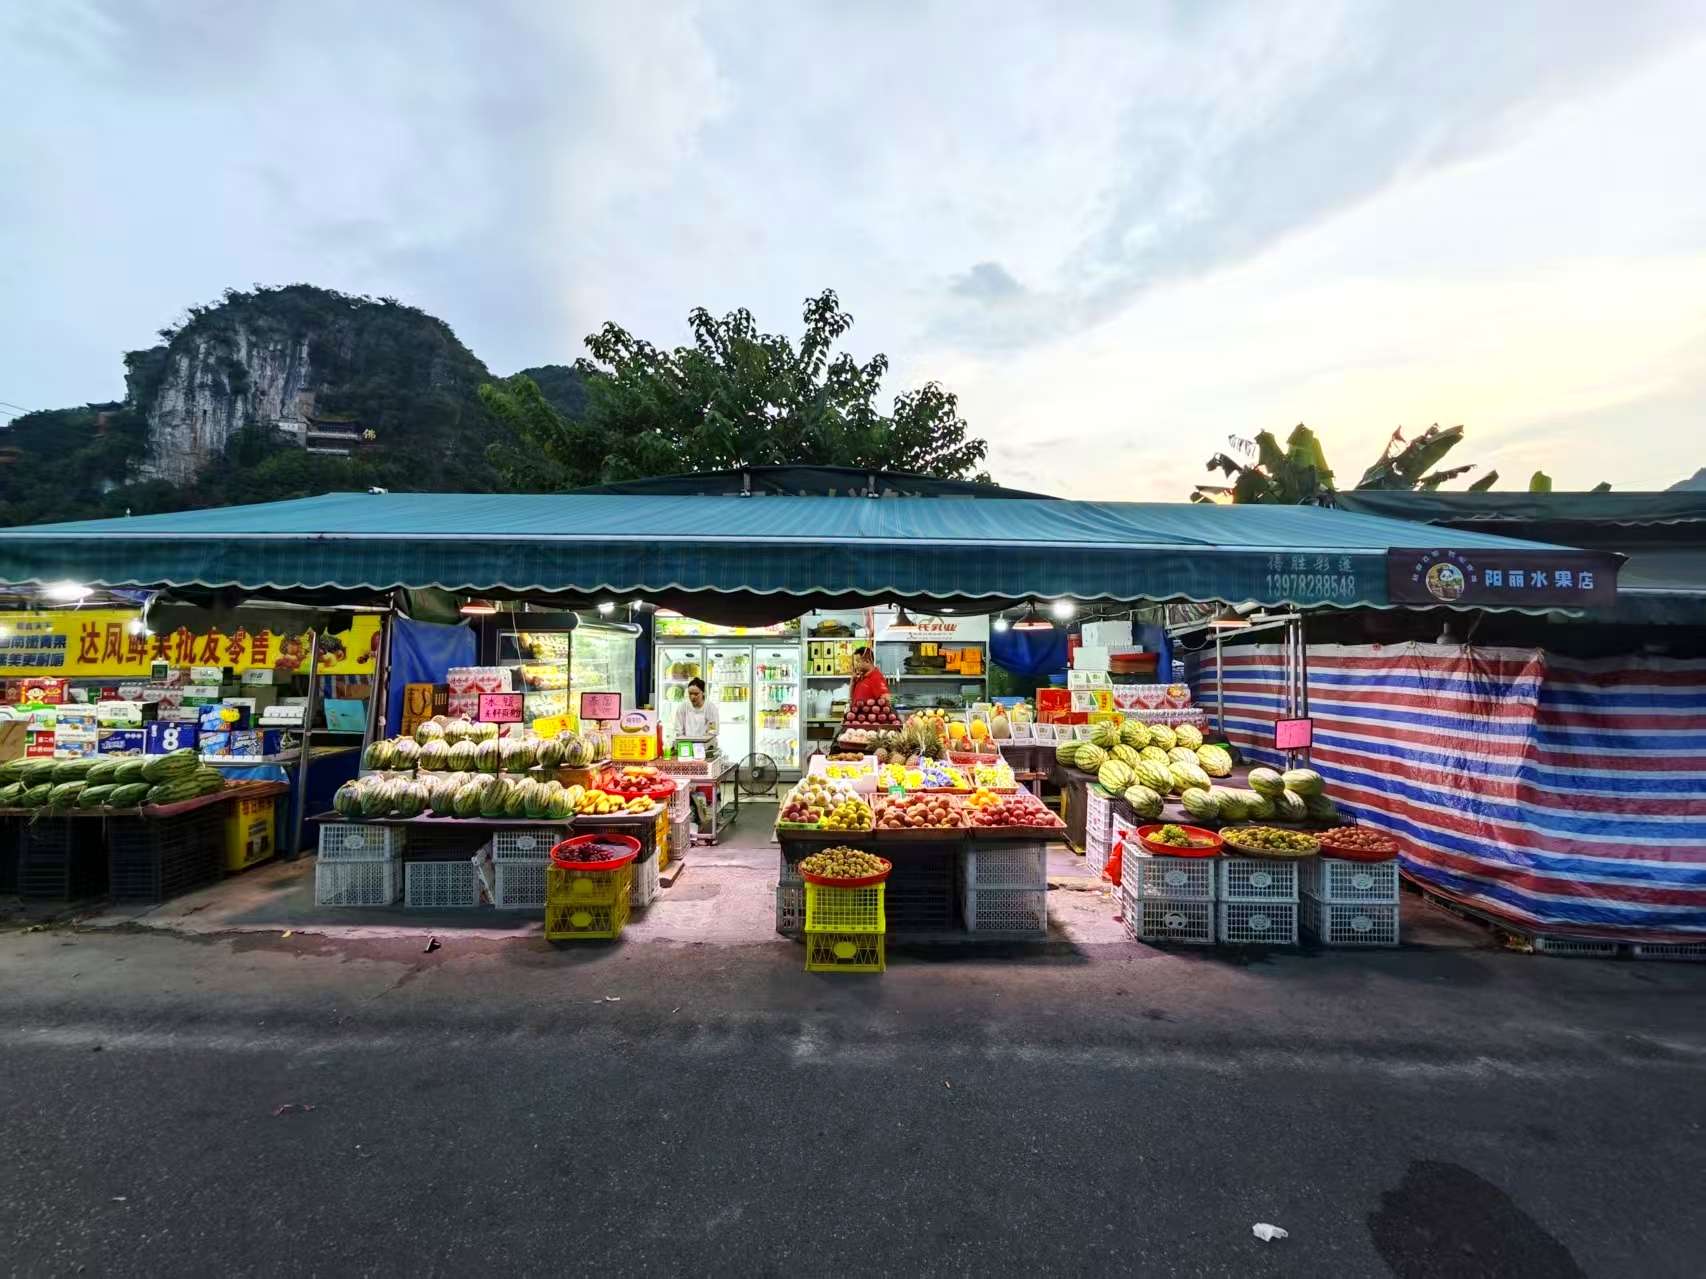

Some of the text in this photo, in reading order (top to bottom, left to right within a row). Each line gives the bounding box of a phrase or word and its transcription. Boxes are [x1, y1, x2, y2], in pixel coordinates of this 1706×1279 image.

[363, 428, 376, 440] 佛
[1266, 574, 1356, 598] 13978288548
[1485, 569, 1594, 590] 阳丽水果店
